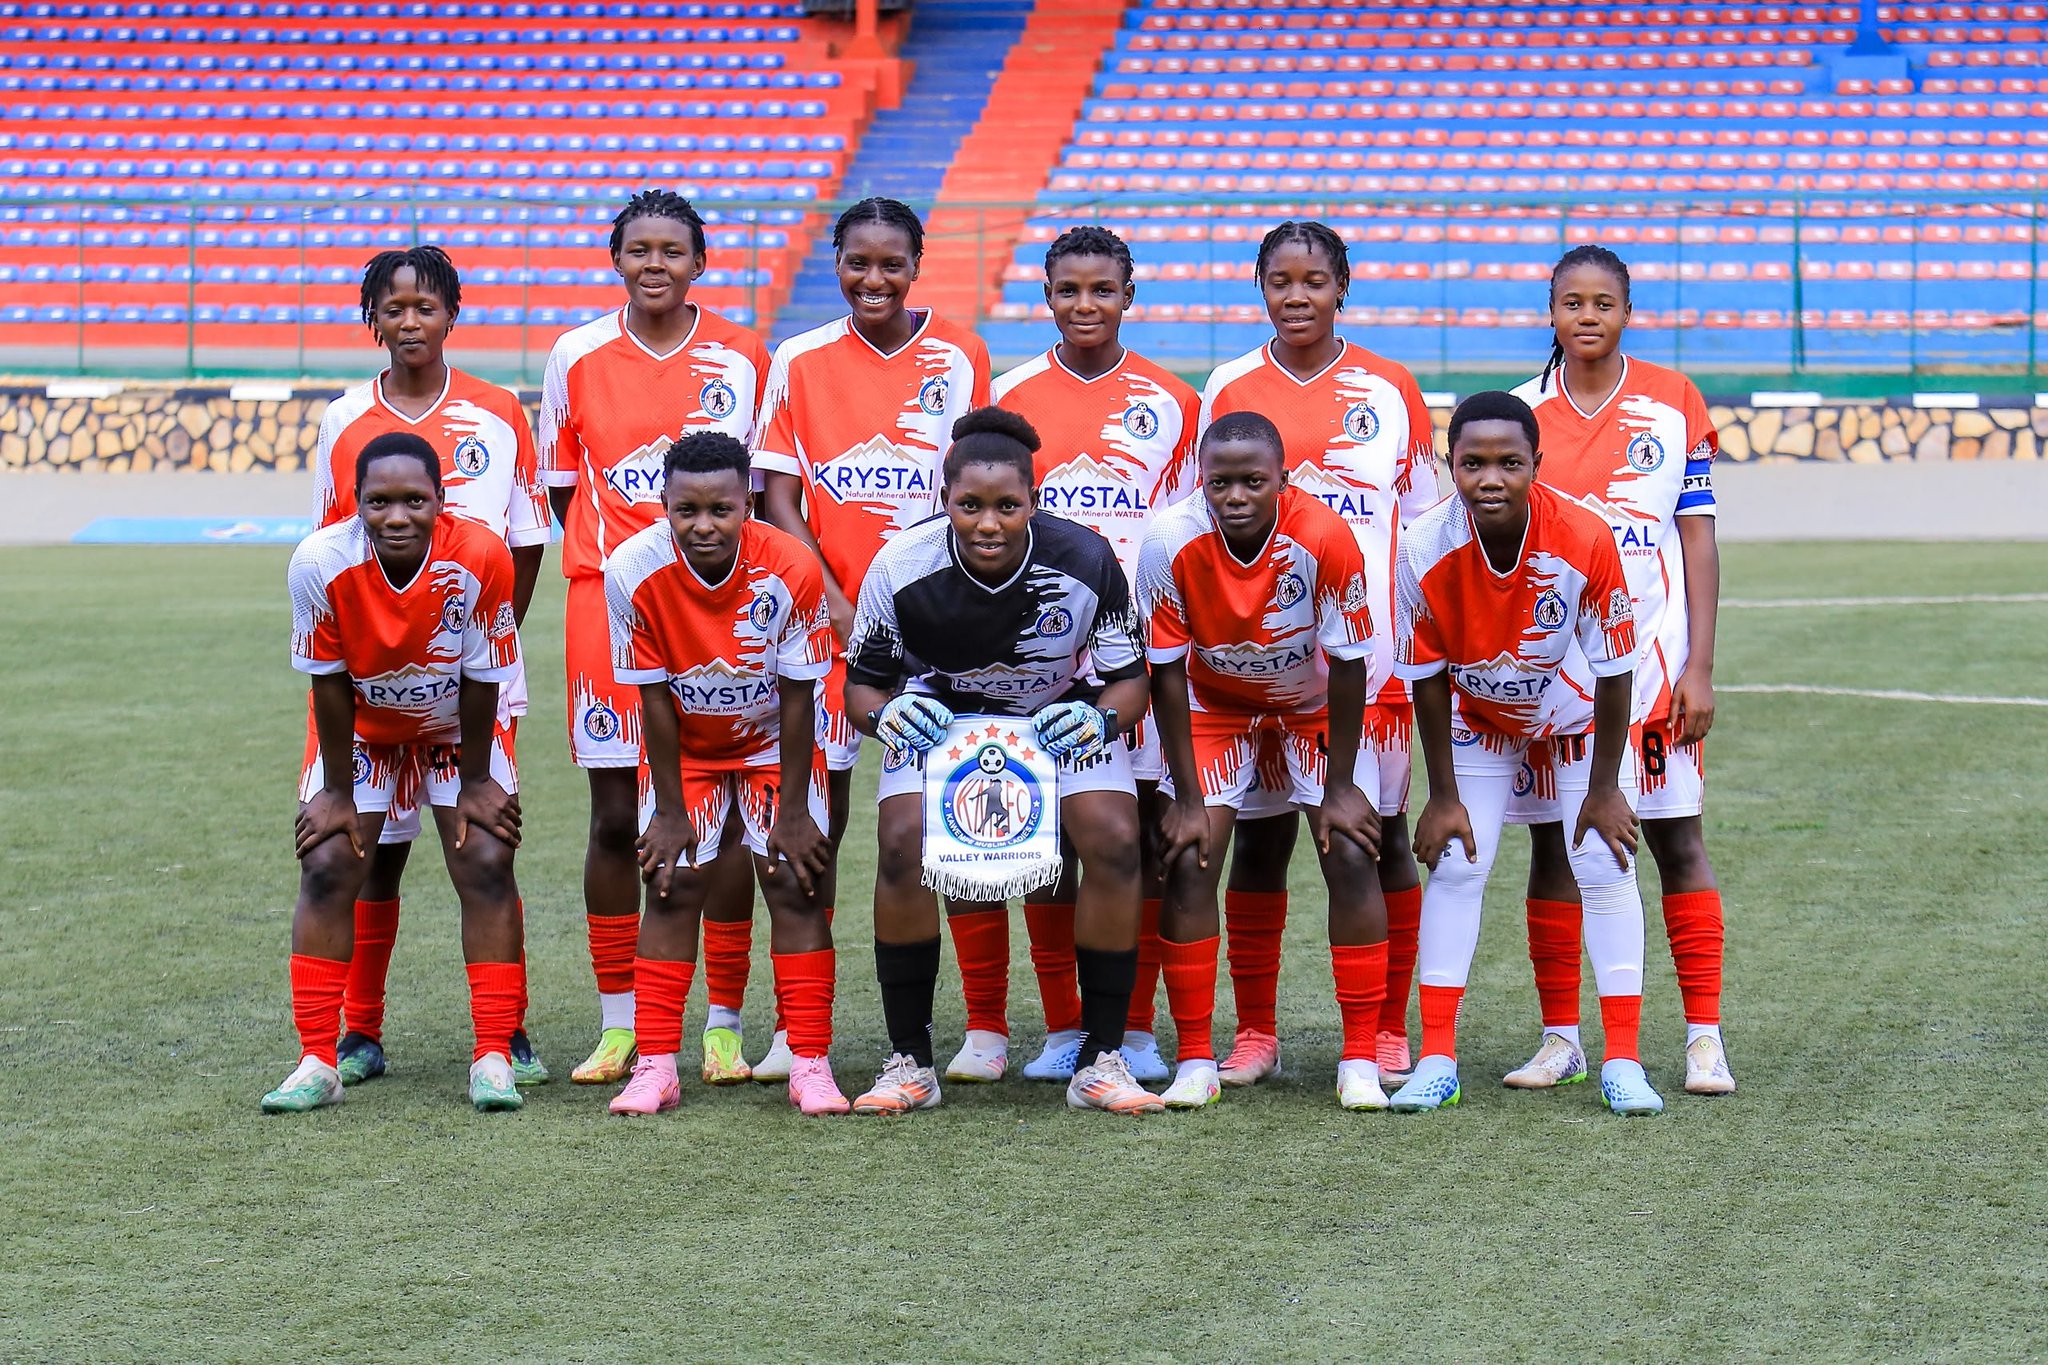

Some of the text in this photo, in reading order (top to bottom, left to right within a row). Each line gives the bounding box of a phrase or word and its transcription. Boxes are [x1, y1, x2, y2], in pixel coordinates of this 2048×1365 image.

[605, 469, 666, 502] KRY
[1681, 477, 1712, 491] PTA
[876, 491, 906, 499] Mineral
[908, 492, 932, 500] WATE
[1038, 486, 1147, 509] RYSTAL
[1624, 549, 1652, 557] WATER
[956, 672, 1064, 691] RYSTAL
[352, 677, 459, 706] RYSTA
[413, 697, 442, 708] Mineral
[690, 704, 721, 713] Natural
[722, 702, 753, 712] Mineral
[1643, 731, 1666, 776] 8
[945, 813, 975, 844] KAWEMPE
[1007, 827, 1032, 845] LADIES
[939, 851, 1042, 862] VALLEY WARRIORS
